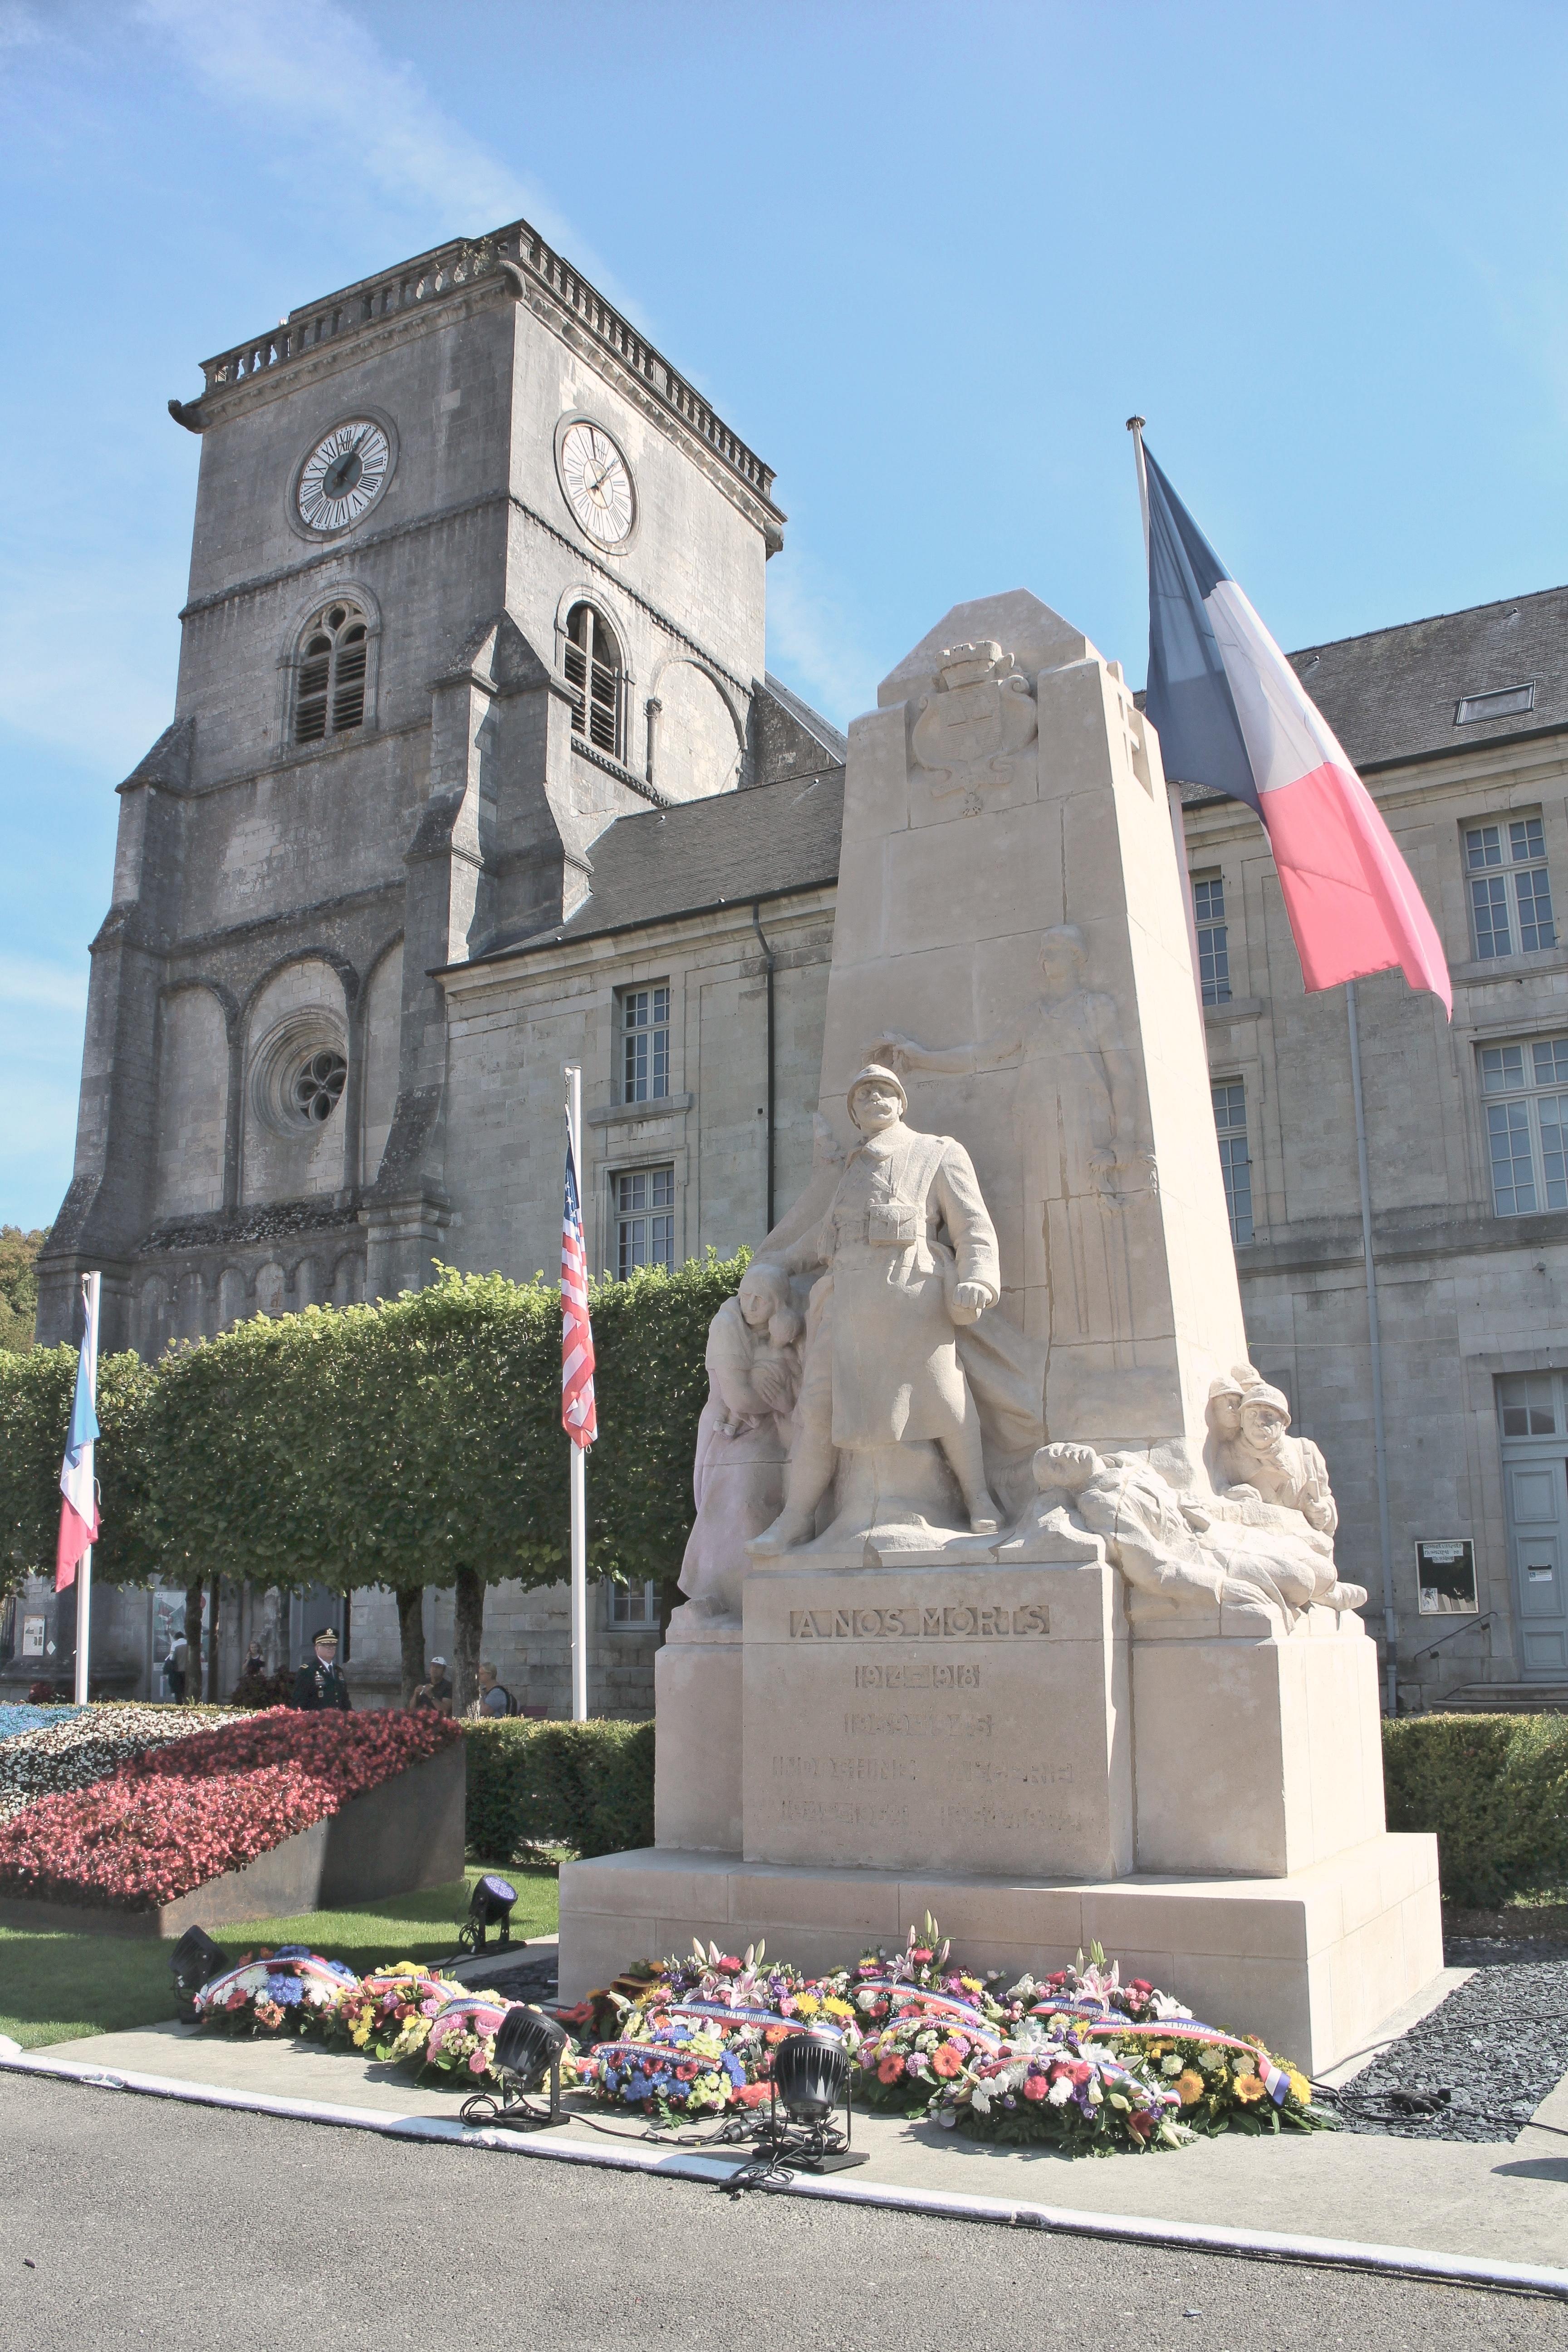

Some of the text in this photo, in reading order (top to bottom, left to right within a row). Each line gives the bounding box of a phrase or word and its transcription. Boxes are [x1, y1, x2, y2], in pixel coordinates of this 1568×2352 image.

[339, 430, 352, 454] XII
[362, 439, 380, 458] II
[321, 441, 337, 463] XI
[309, 463, 327, 475] X
[364, 456, 383, 471] III
[303, 480, 322, 497] IX
[358, 476, 379, 492] IIII
[335, 500, 346, 523] VI
[352, 493, 363, 511] V
[316, 500, 332, 524] VII
[795, 1606, 1045, 1637] A NOS MORTS
